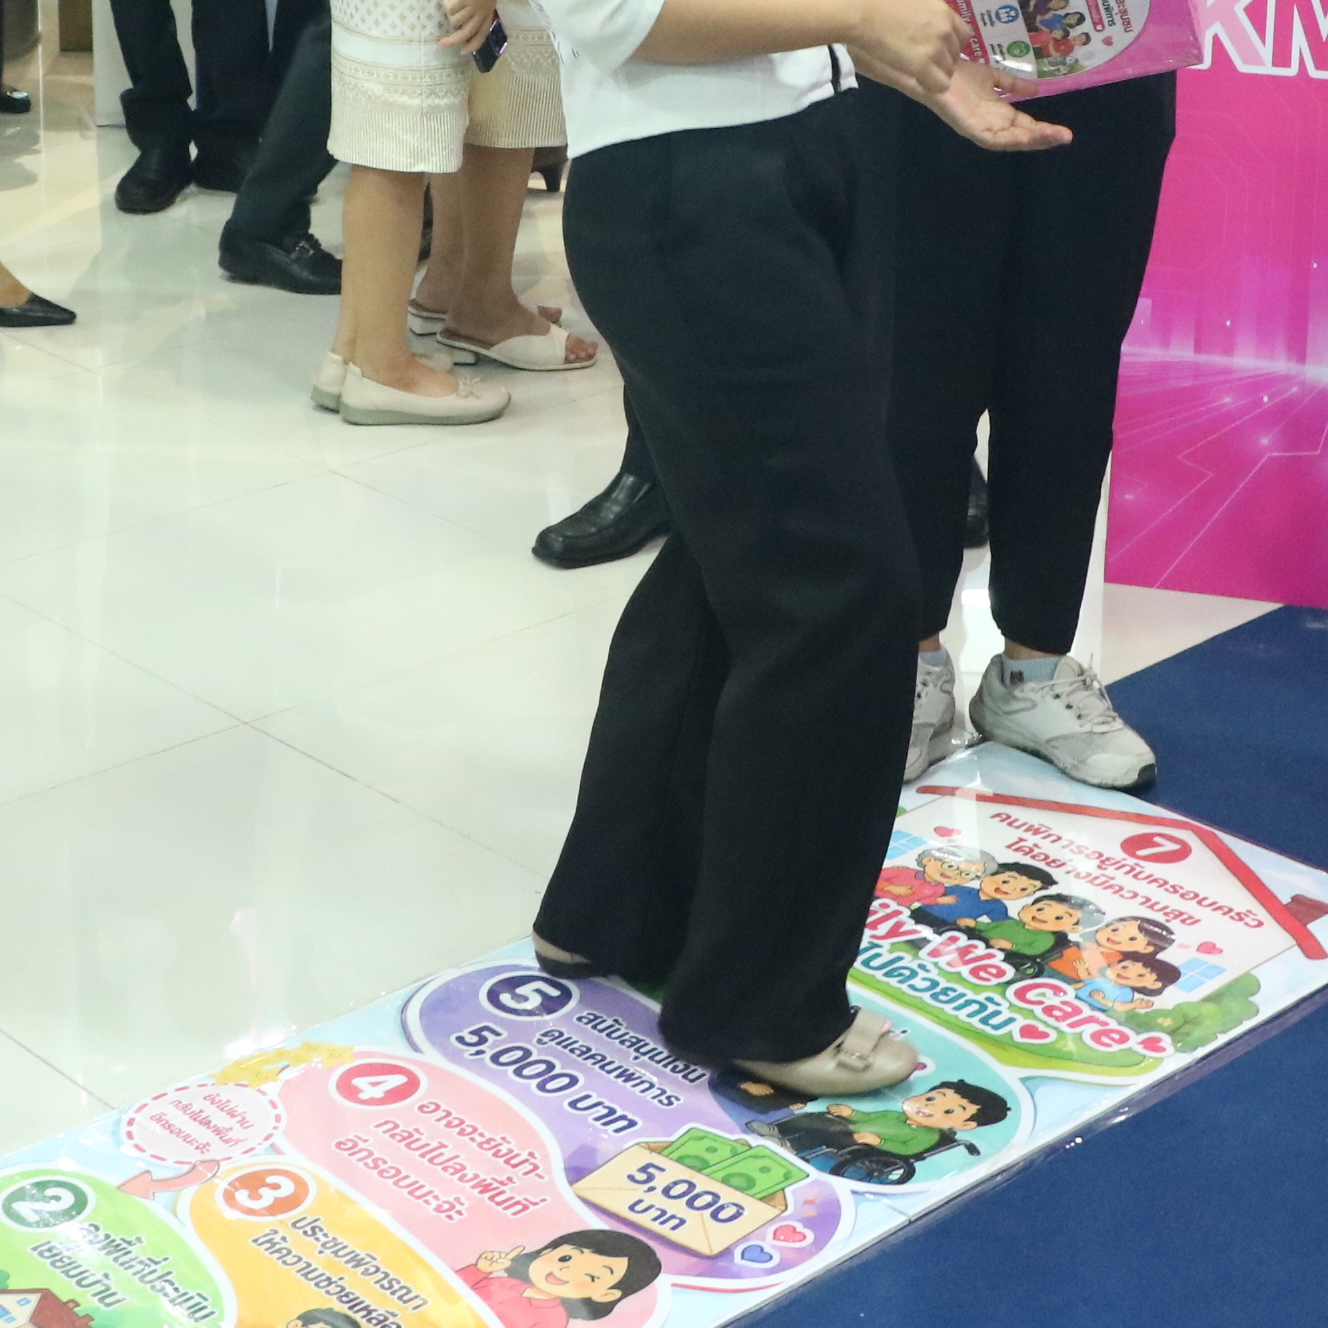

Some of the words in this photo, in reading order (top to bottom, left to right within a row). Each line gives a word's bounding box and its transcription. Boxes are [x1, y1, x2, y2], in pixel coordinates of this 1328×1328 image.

[990, 811, 1264, 929] คนพิการอยู่กับครอบครัว
[1005, 836, 1203, 927] ได้อย่างมีความสุข
[1135, 836, 1181, 856] 7
[499, 980, 561, 1010] 5
[859, 940, 1019, 1031] ไปด้วยกัน
[926, 935, 1007, 983] We
[1013, 982, 1130, 1048] Care
[455, 1024, 580, 1094] 5,000
[567, 1093, 638, 1134] บาท
[536, 1027, 681, 1108] ดูแลคนพิการ
[574, 1010, 708, 1084] สนับสนุนเงน
[351, 1073, 409, 1100] 4
[11, 1186, 75, 1223] 2
[234, 1174, 296, 1209] 3
[373, 1118, 548, 1217] กลับไปลงพื้นที่
[624, 1159, 747, 1226] 5,000
[628, 1195, 687, 1235] บาท
[290, 1216, 429, 1312] ประชุมพิจารณา
